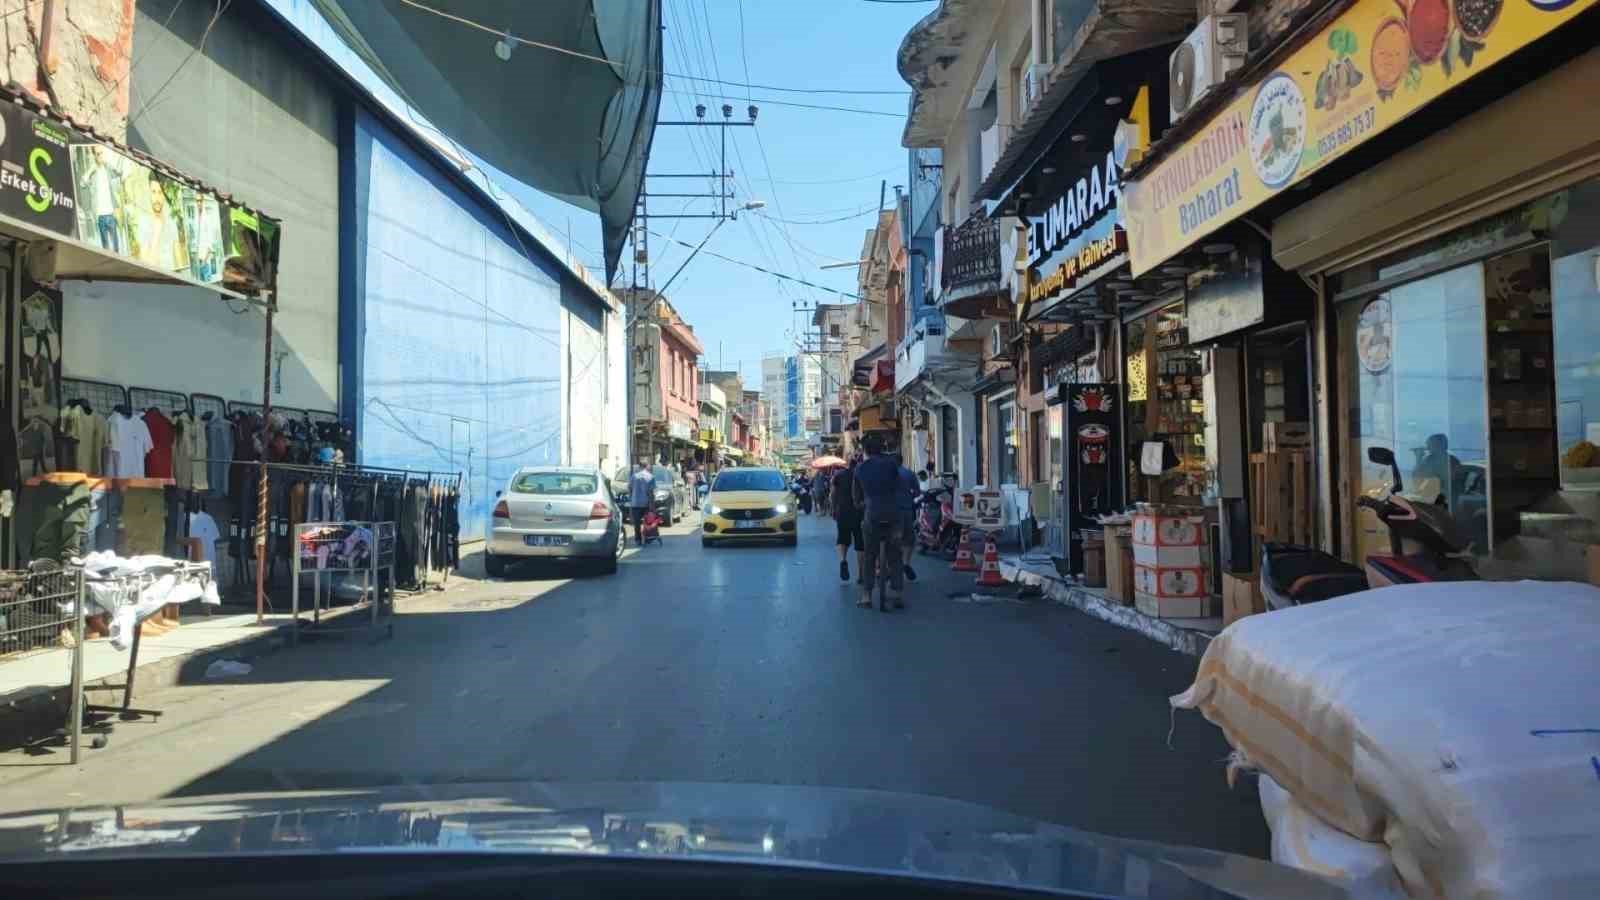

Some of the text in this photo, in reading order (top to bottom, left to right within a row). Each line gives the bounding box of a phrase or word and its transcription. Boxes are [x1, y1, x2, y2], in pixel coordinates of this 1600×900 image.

[1, 169, 73, 208] Erkek Giyim
[1179, 168, 1242, 235] Baharat
